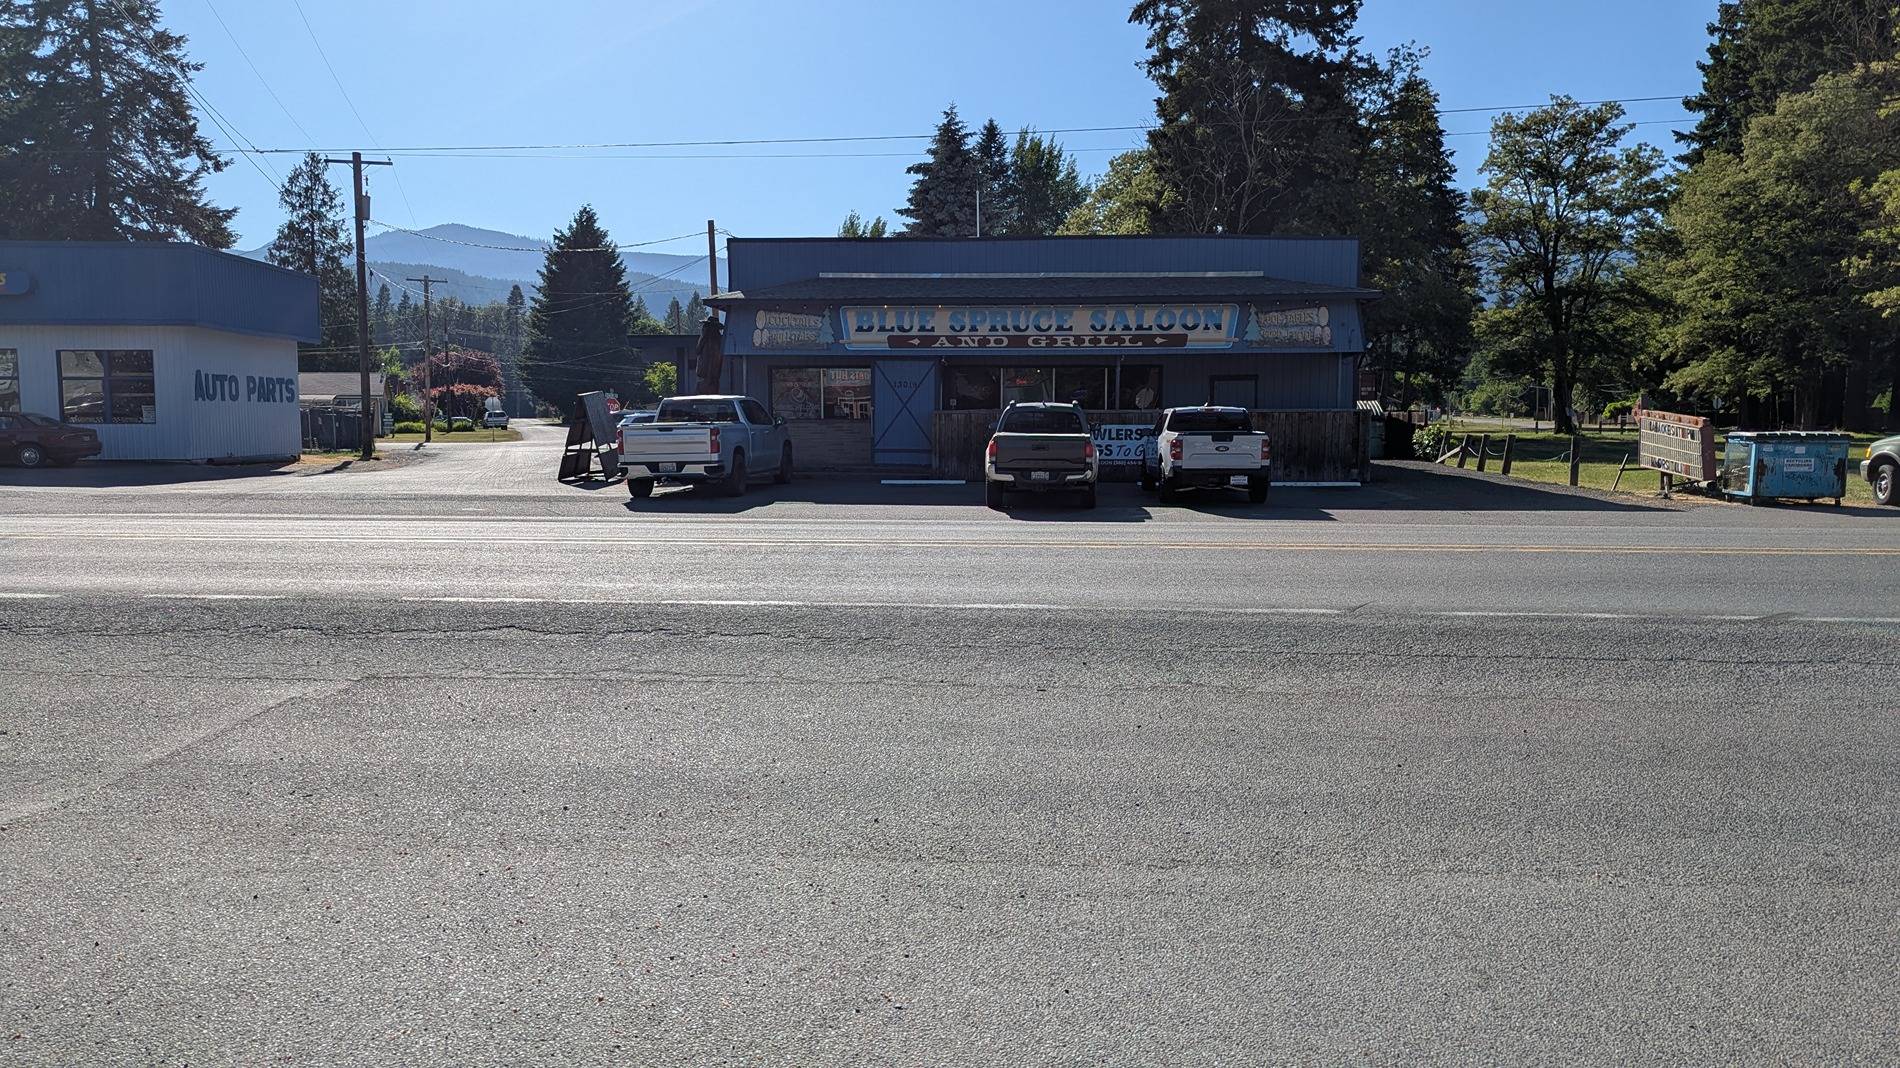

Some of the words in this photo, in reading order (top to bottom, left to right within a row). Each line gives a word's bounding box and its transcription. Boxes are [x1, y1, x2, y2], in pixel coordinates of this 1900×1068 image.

[855, 309, 936, 333] BLUE
[949, 308, 1074, 333] SPRUCE
[1090, 306, 1223, 332] SALOON
[932, 336, 1009, 348] AND
[1027, 335, 1143, 347] GRILL
[194, 369, 240, 402] AUTO
[246, 375, 295, 402] PARTS
[1093, 428, 1143, 441] WLERS
[1095, 444, 1113, 457] GS
[1134, 444, 1145, 457] G
